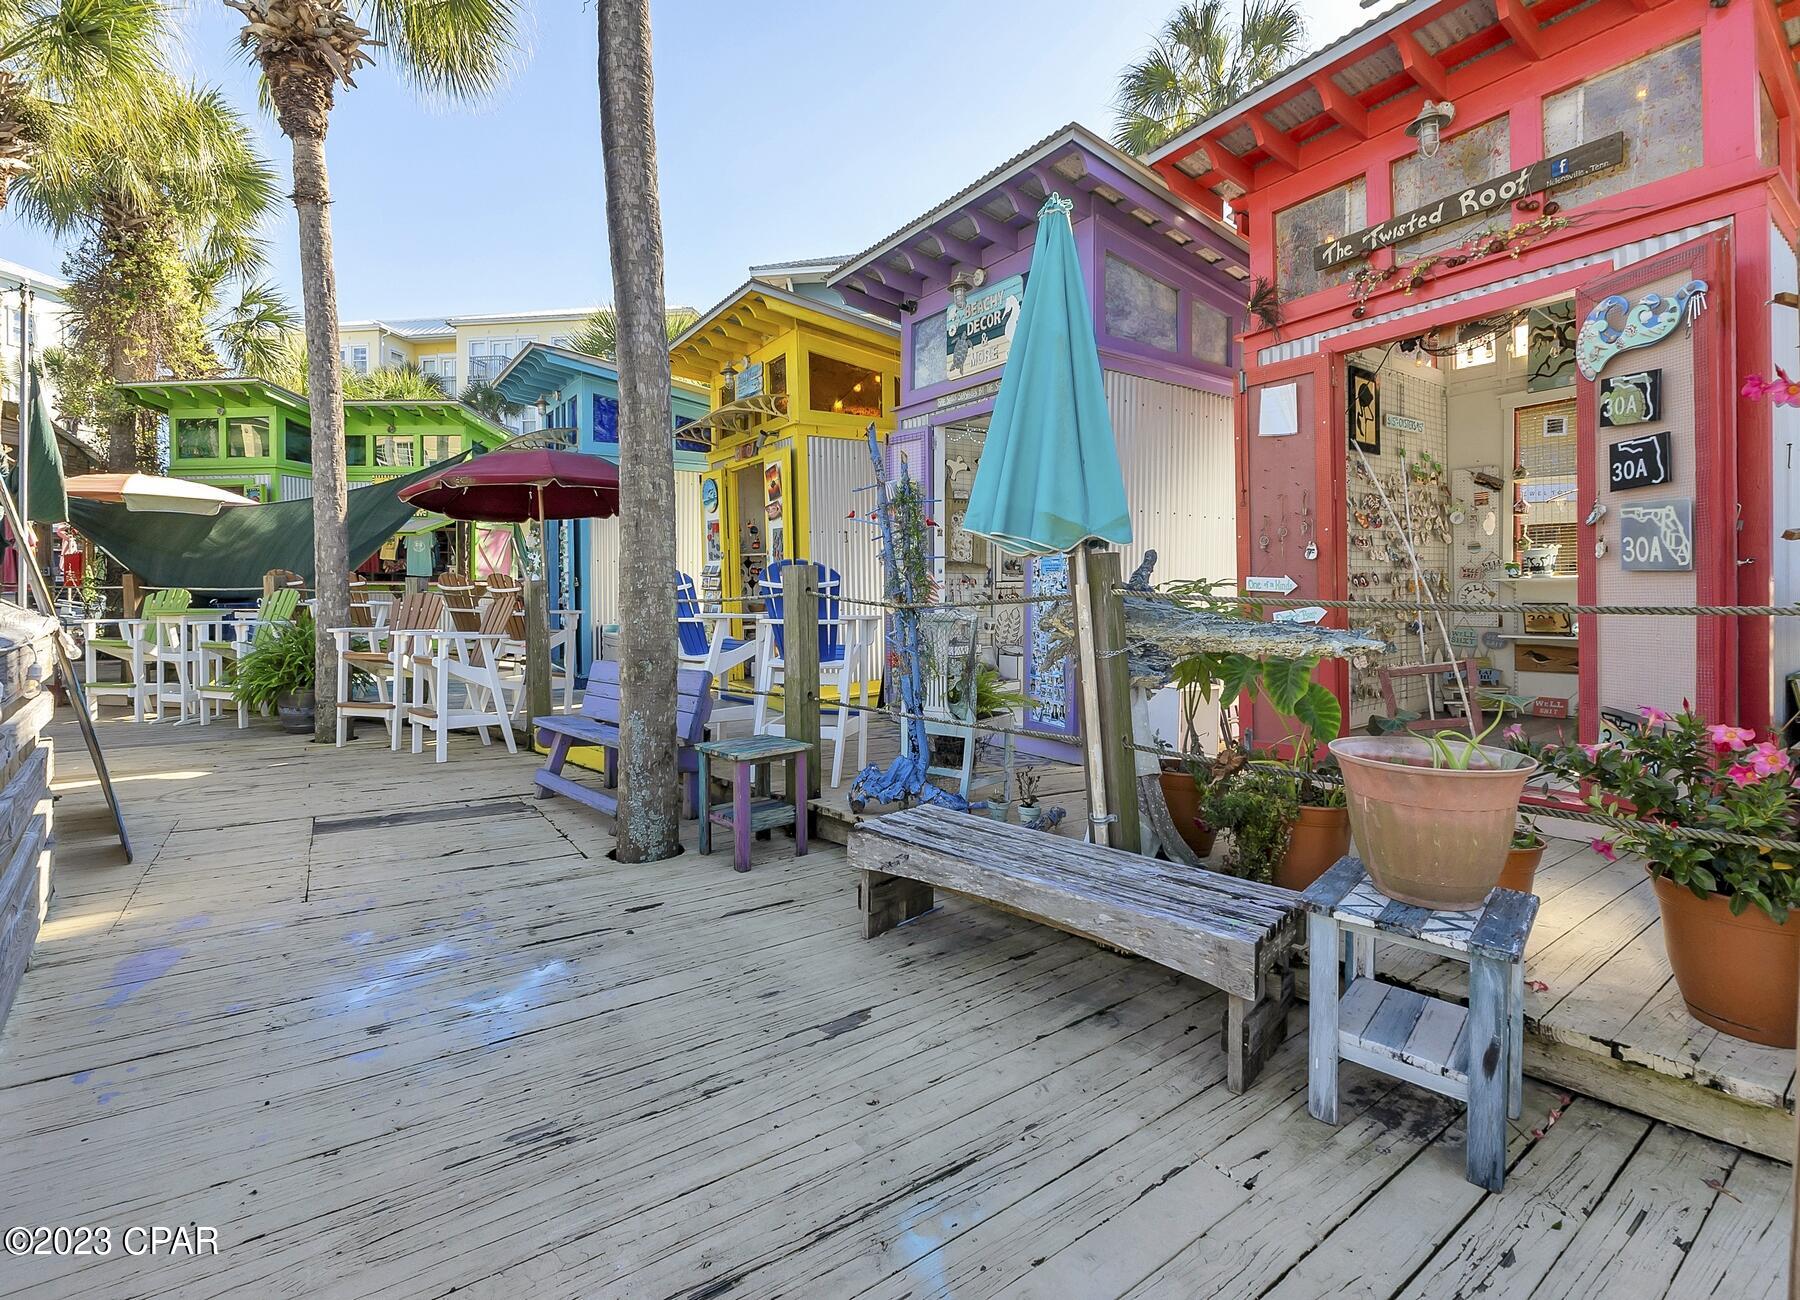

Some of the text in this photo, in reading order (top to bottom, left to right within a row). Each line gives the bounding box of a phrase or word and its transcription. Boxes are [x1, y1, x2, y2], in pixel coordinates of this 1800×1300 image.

[1322, 168, 1530, 265] The Twisted Root
[964, 289, 1006, 319] BEACHY
[966, 310, 1002, 337] DECOR
[981, 332, 989, 346] &
[969, 345, 1000, 368] MORE
[1603, 394, 1638, 418] 30A
[1612, 458, 1648, 482] 30A
[1622, 535, 1664, 563] 30A
